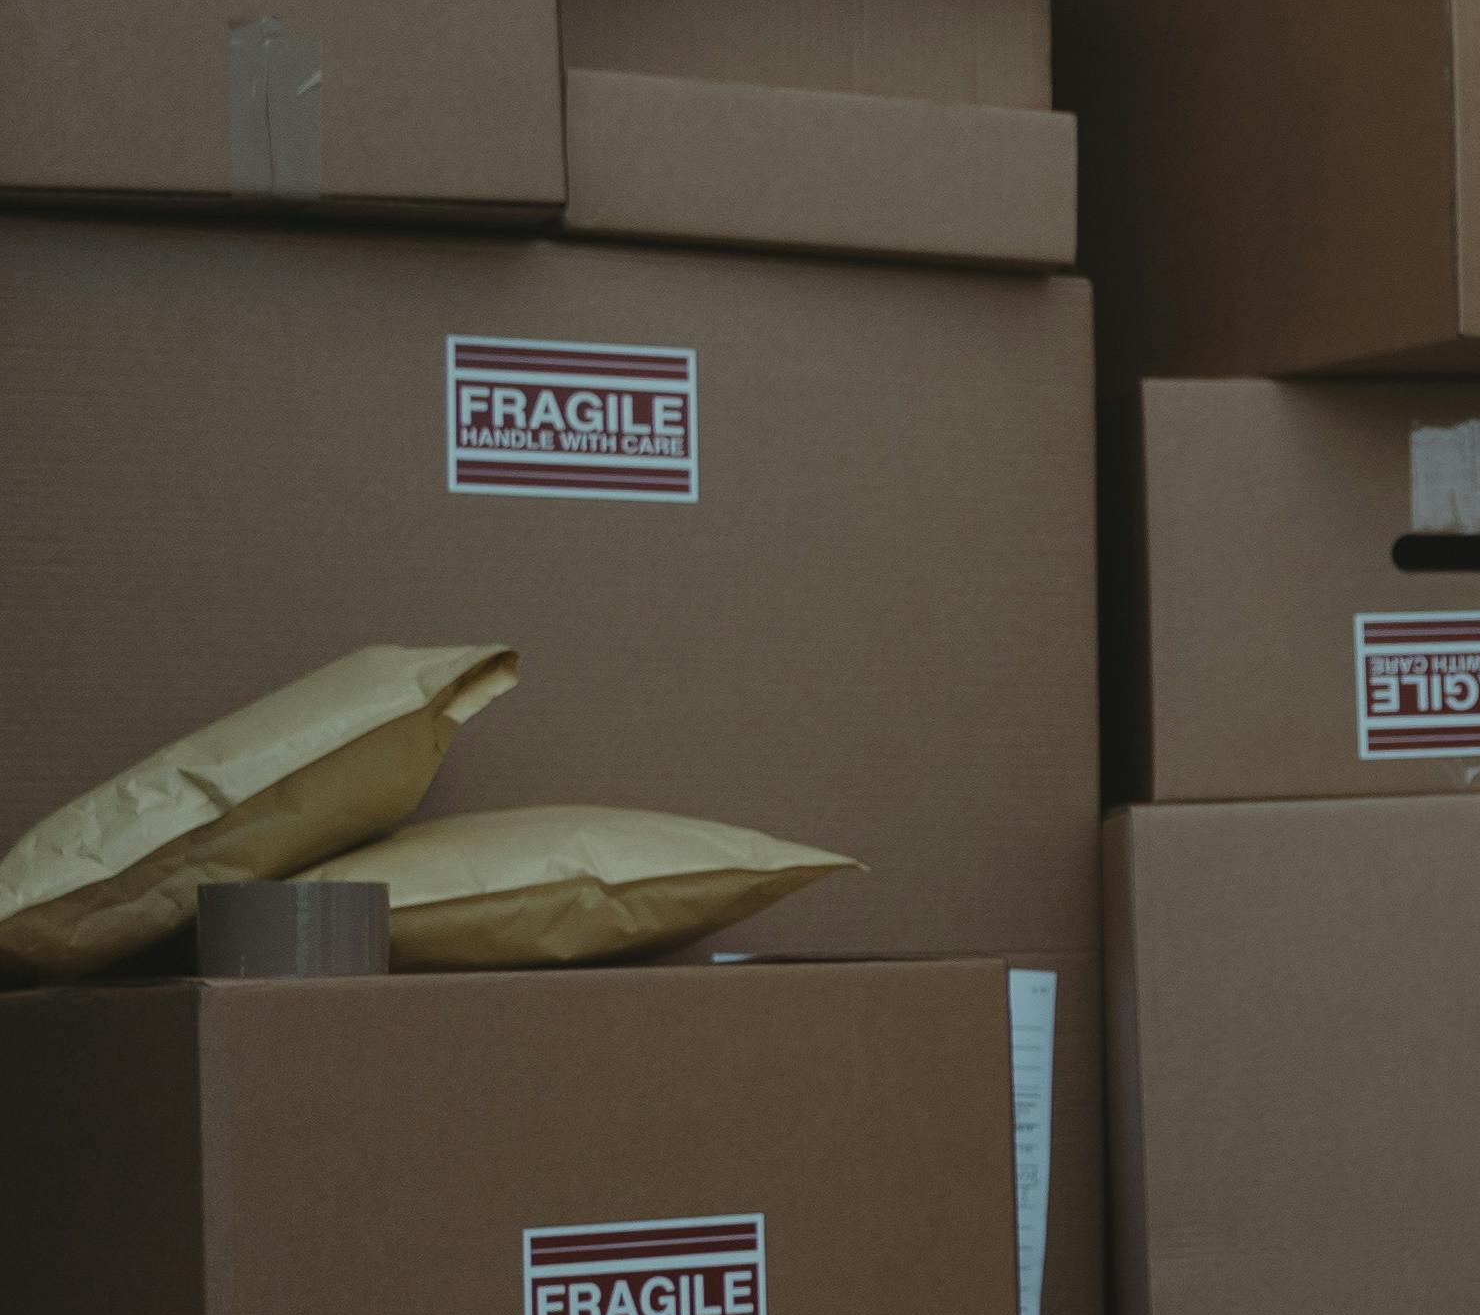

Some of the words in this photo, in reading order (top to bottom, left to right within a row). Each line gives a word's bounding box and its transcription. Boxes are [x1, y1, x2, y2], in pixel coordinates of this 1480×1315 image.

[459, 385, 686, 436] FRAGILE
[461, 427, 555, 451] HANDLE
[558, 431, 618, 454] WITH
[621, 434, 685, 456] CARE
[1370, 654, 1428, 675] CARE
